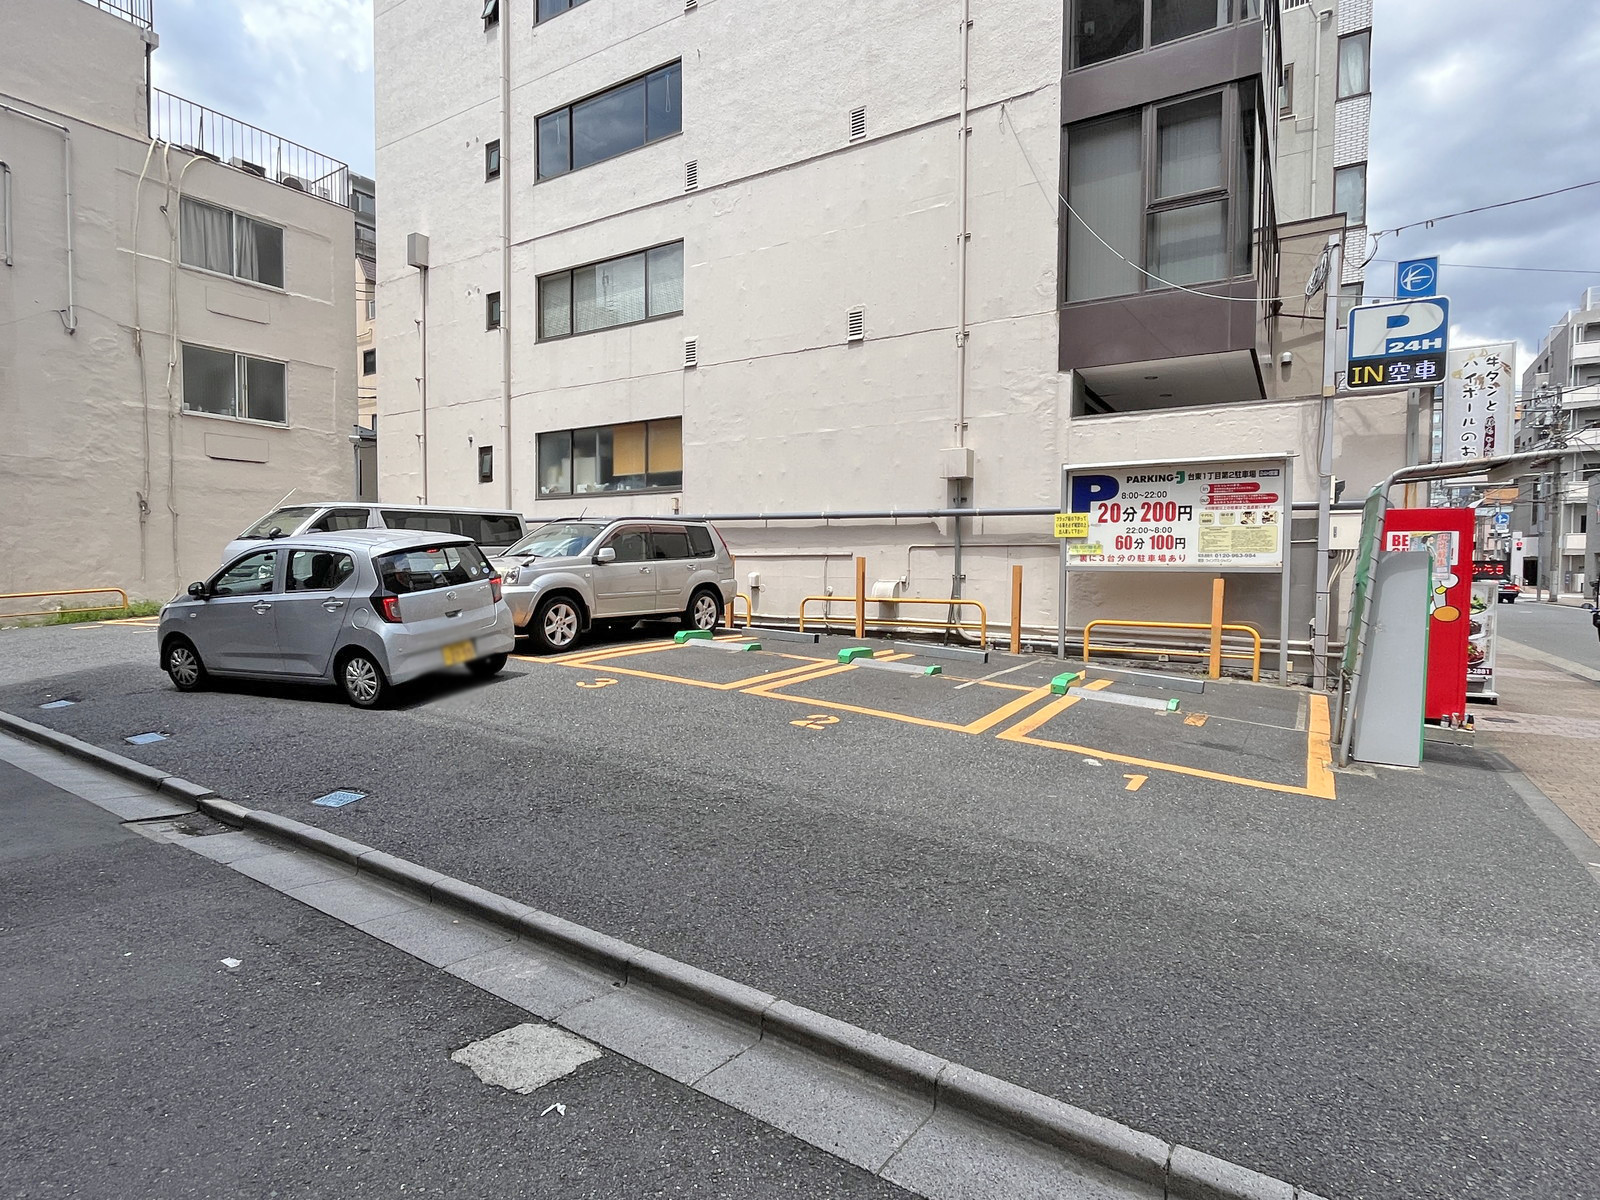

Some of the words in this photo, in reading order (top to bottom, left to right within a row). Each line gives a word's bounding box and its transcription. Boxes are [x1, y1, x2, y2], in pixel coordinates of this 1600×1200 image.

[1352, 302, 1444, 358] P
[1388, 338, 1442, 354] 24H
[1352, 364, 1383, 385] IN
[1388, 359, 1437, 384] 空車
[1071, 474, 1121, 514] P
[1097, 502, 1138, 524] 20分
[1140, 501, 1193, 523] 200円
[1114, 535, 1146, 551] 60分
[1148, 534, 1187, 551] 100円
[1392, 534, 1409, 547] BE
[789, 713, 840, 731] 2
[1122, 773, 1149, 792] 1
